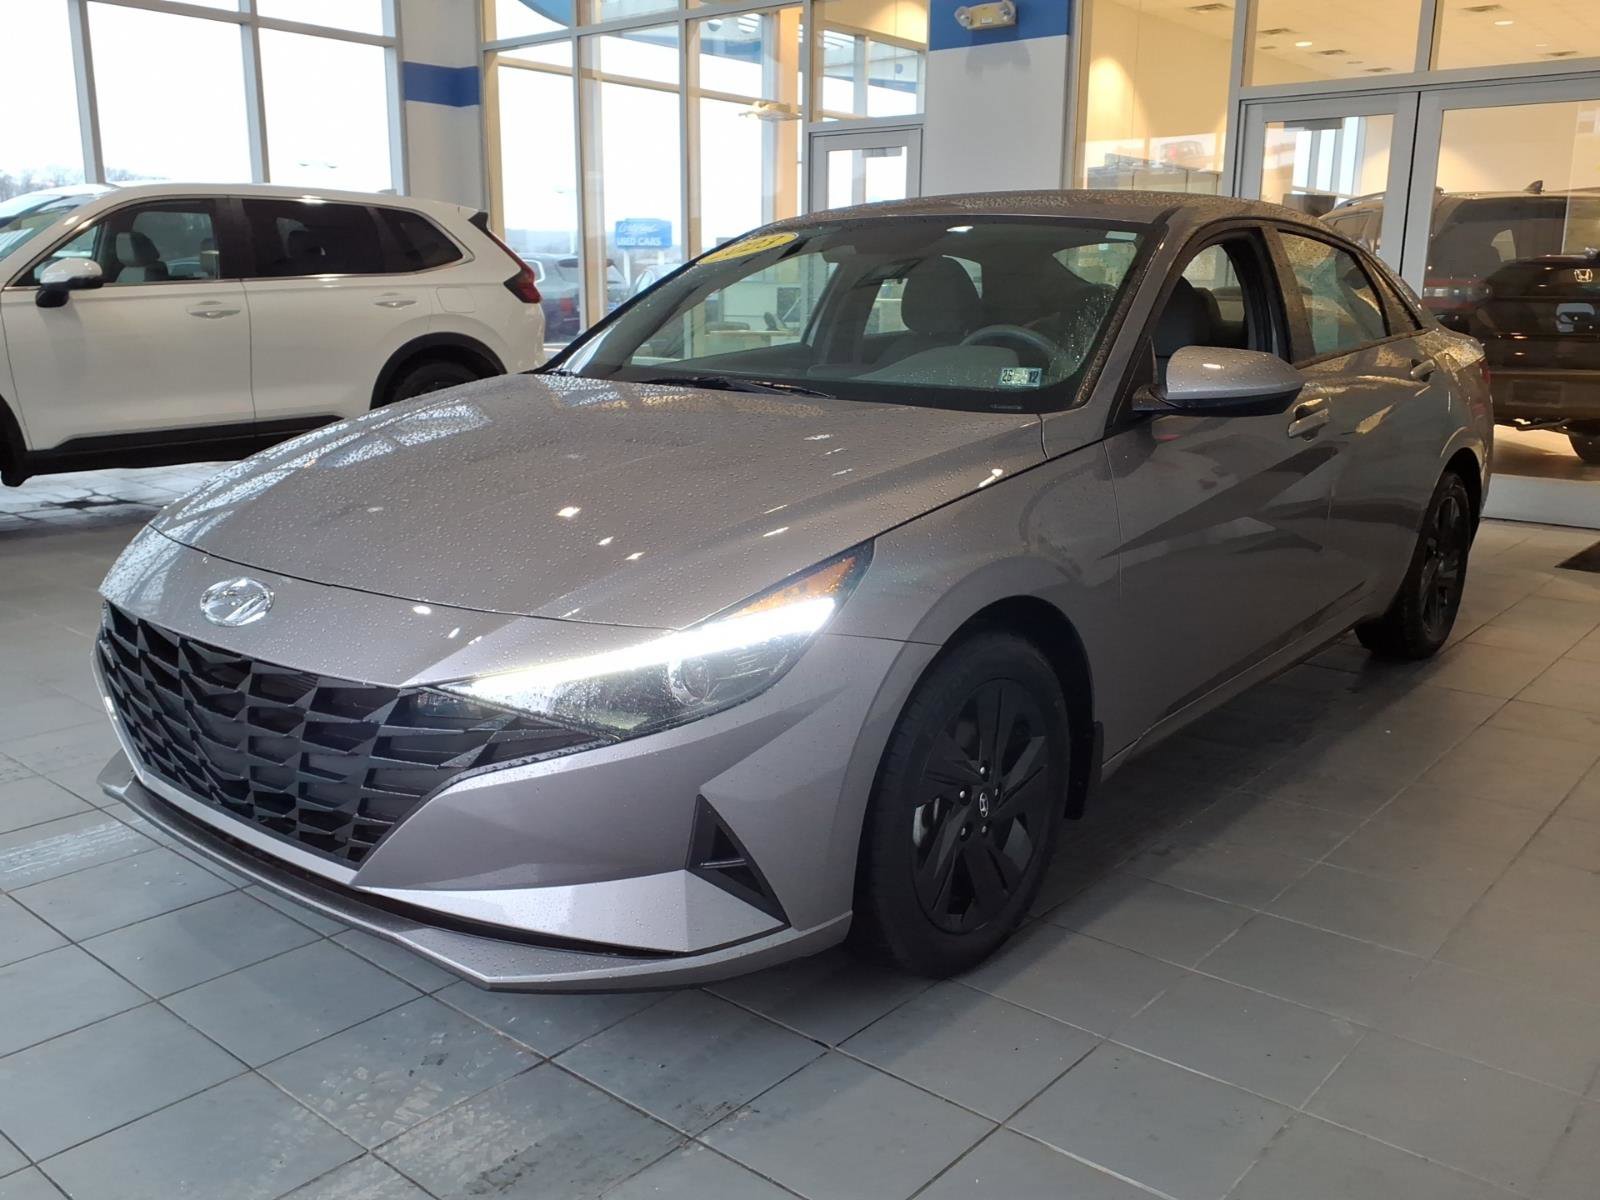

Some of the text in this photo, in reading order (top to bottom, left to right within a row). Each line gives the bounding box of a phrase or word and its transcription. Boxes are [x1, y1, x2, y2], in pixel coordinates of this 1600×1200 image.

[617, 236, 662, 247] USED CARS
[1029, 370, 1039, 383] 12
